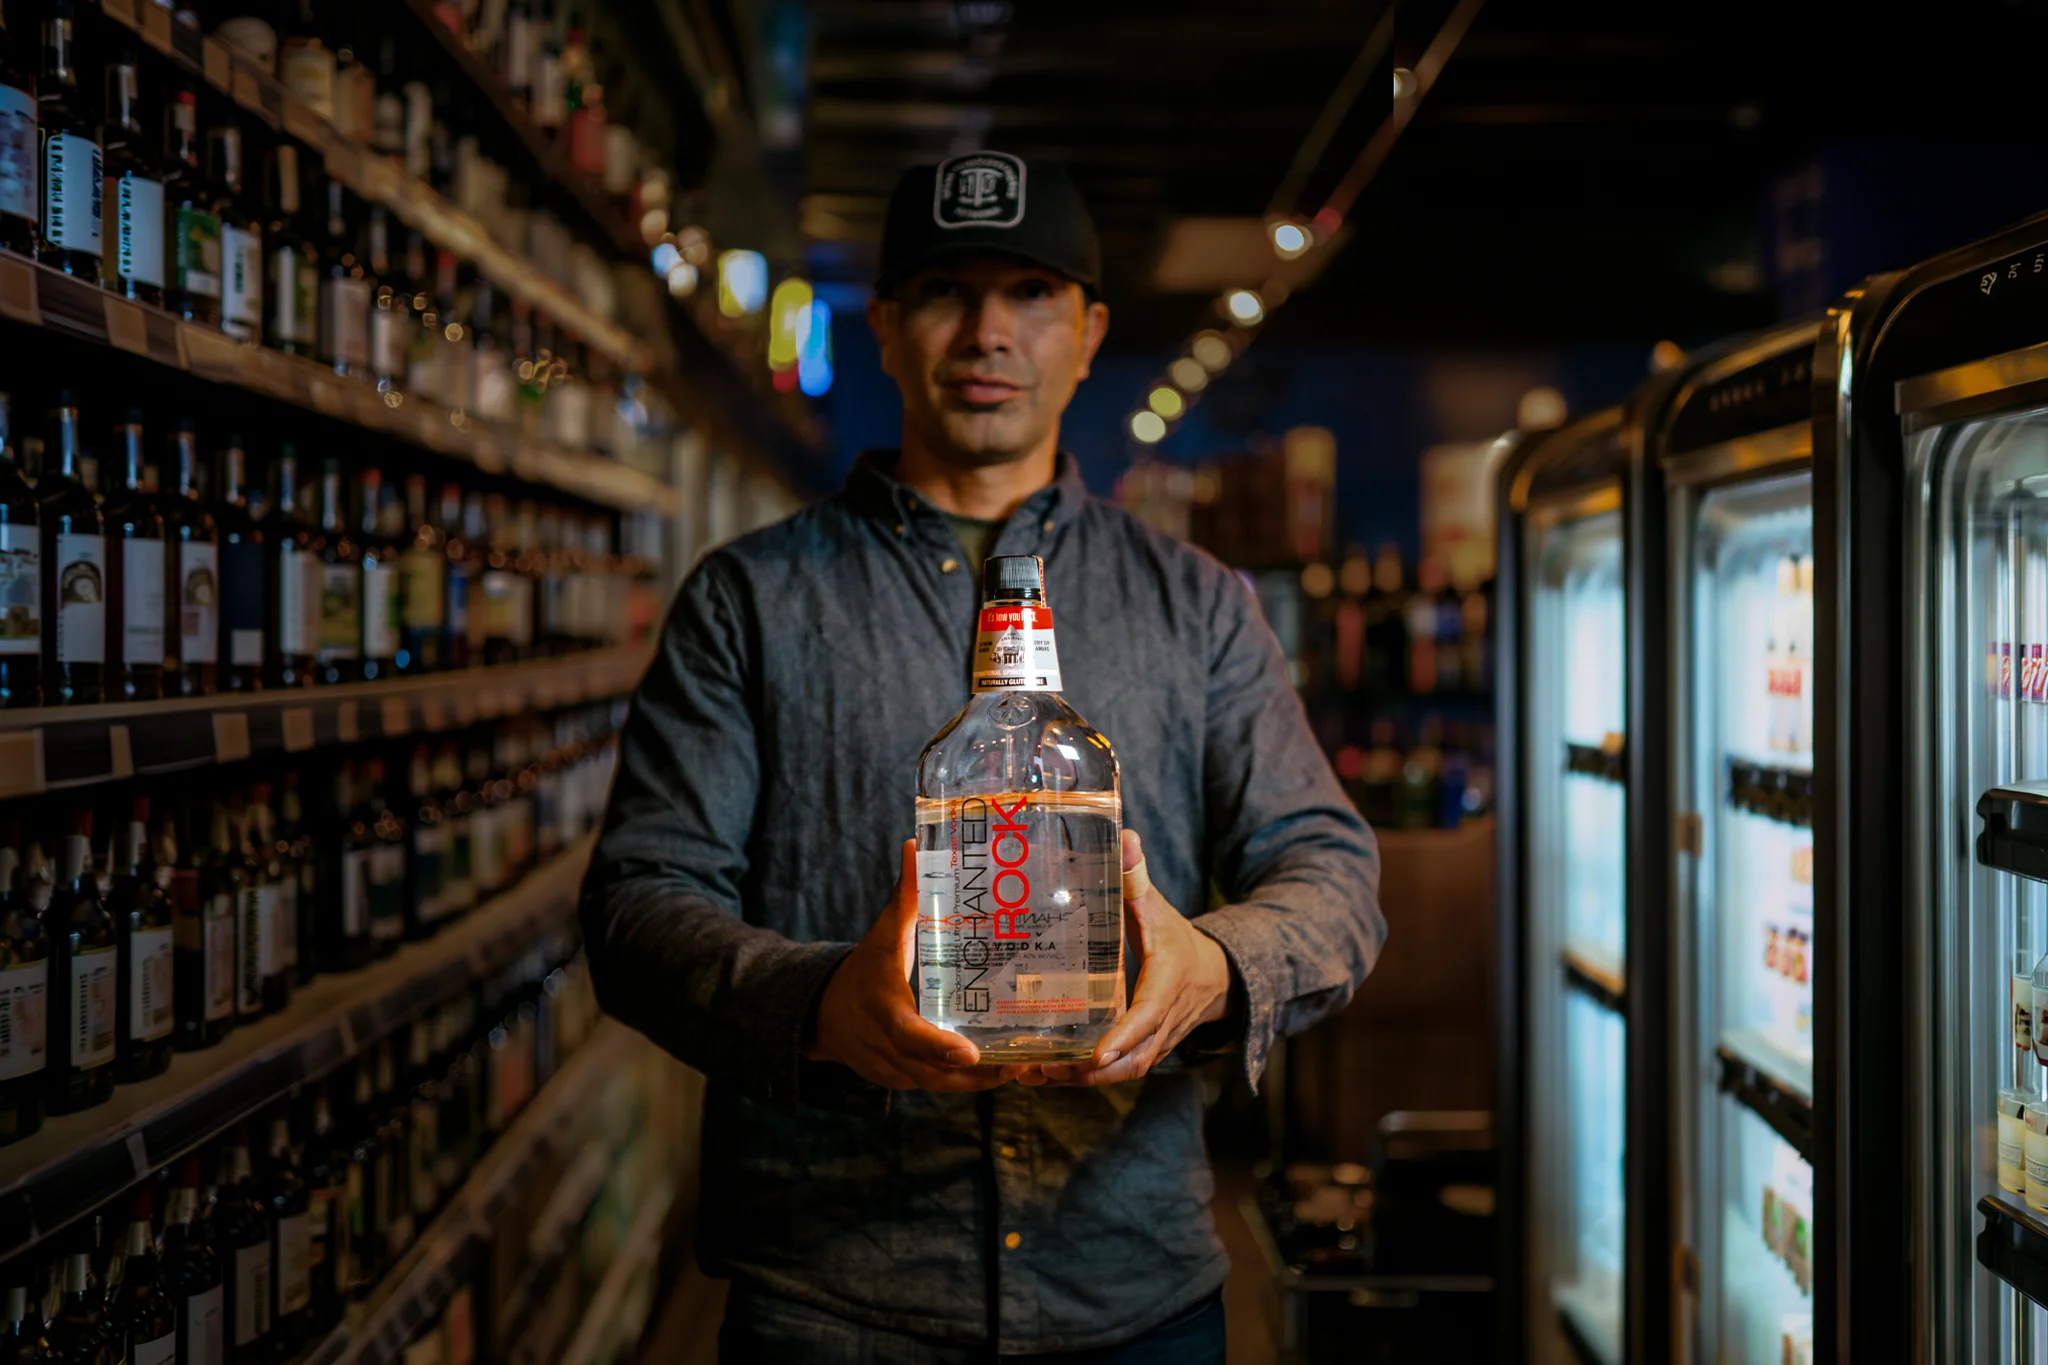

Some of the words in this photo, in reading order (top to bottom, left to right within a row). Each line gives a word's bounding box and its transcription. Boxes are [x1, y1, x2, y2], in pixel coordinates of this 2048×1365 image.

[1008, 612, 1021, 623] you
[950, 836, 958, 868] Texas
[992, 796, 1029, 939] ROCK
[953, 869, 961, 914] Premium
[962, 798, 989, 1012] ENCHANTED
[994, 942, 1056, 951] VODKA
